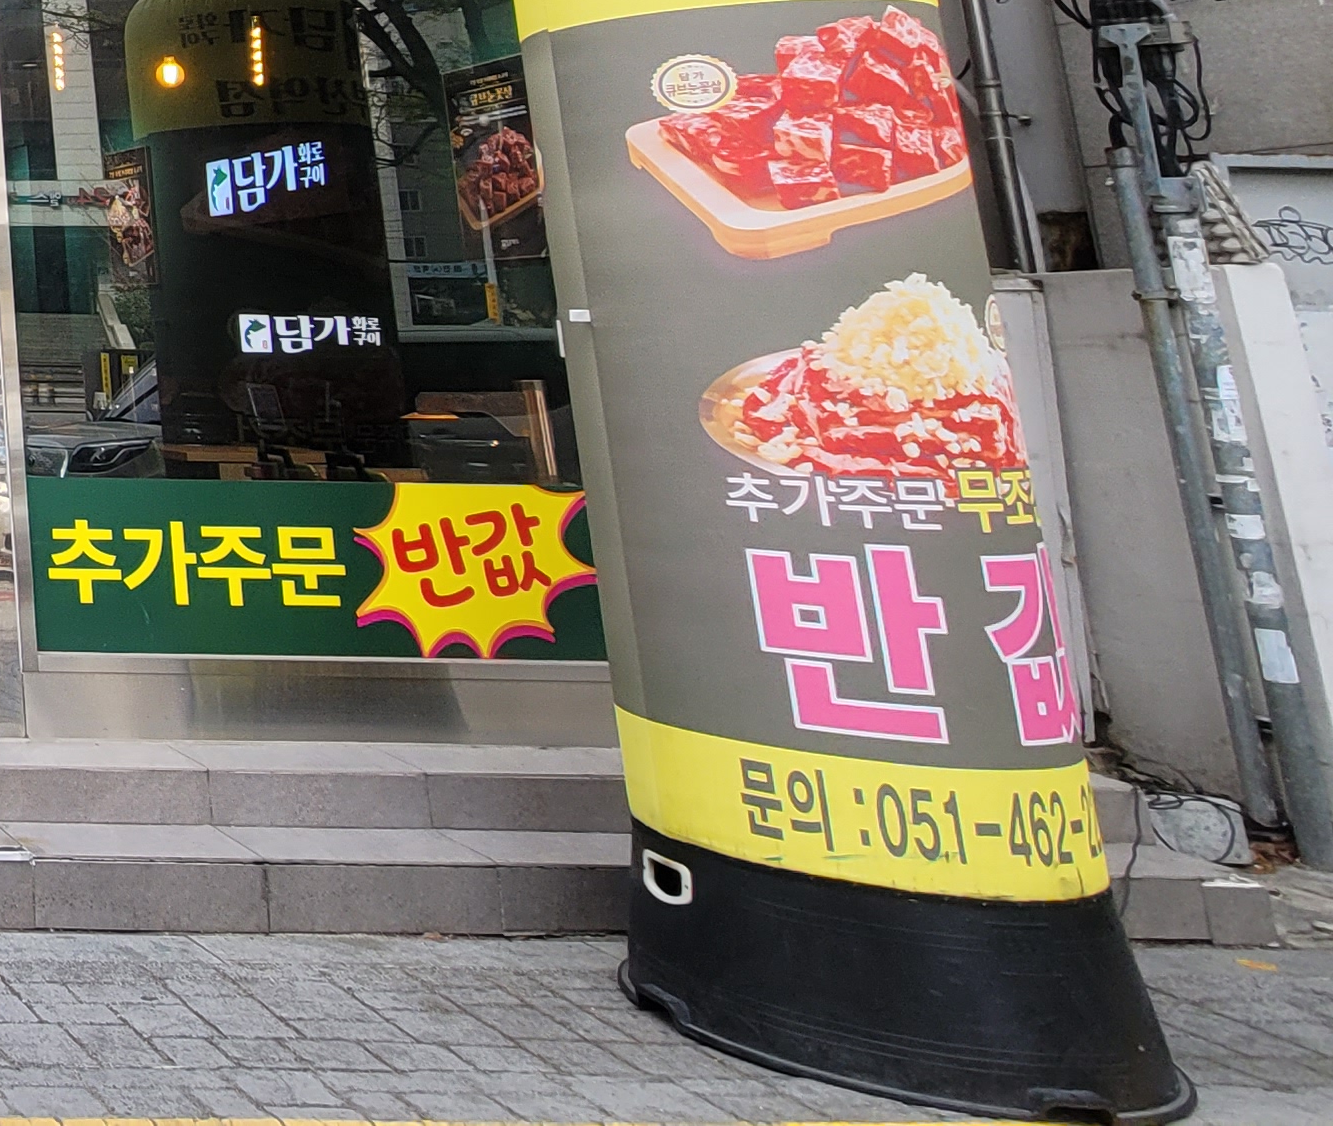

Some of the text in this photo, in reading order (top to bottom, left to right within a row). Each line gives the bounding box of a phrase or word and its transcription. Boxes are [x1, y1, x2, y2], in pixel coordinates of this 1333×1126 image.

[665, 80, 722, 97] 큐브눈꽃살
[233, 141, 323, 212] 담가 화로
[298, 162, 326, 186] 구이
[275, 315, 381, 353] 담가 화로
[352, 331, 381, 346] 구이
[725, 468, 1042, 534] 추가주문 무조
[47, 502, 552, 609] 추가주문 반값
[740, 757, 835, 852] 문의
